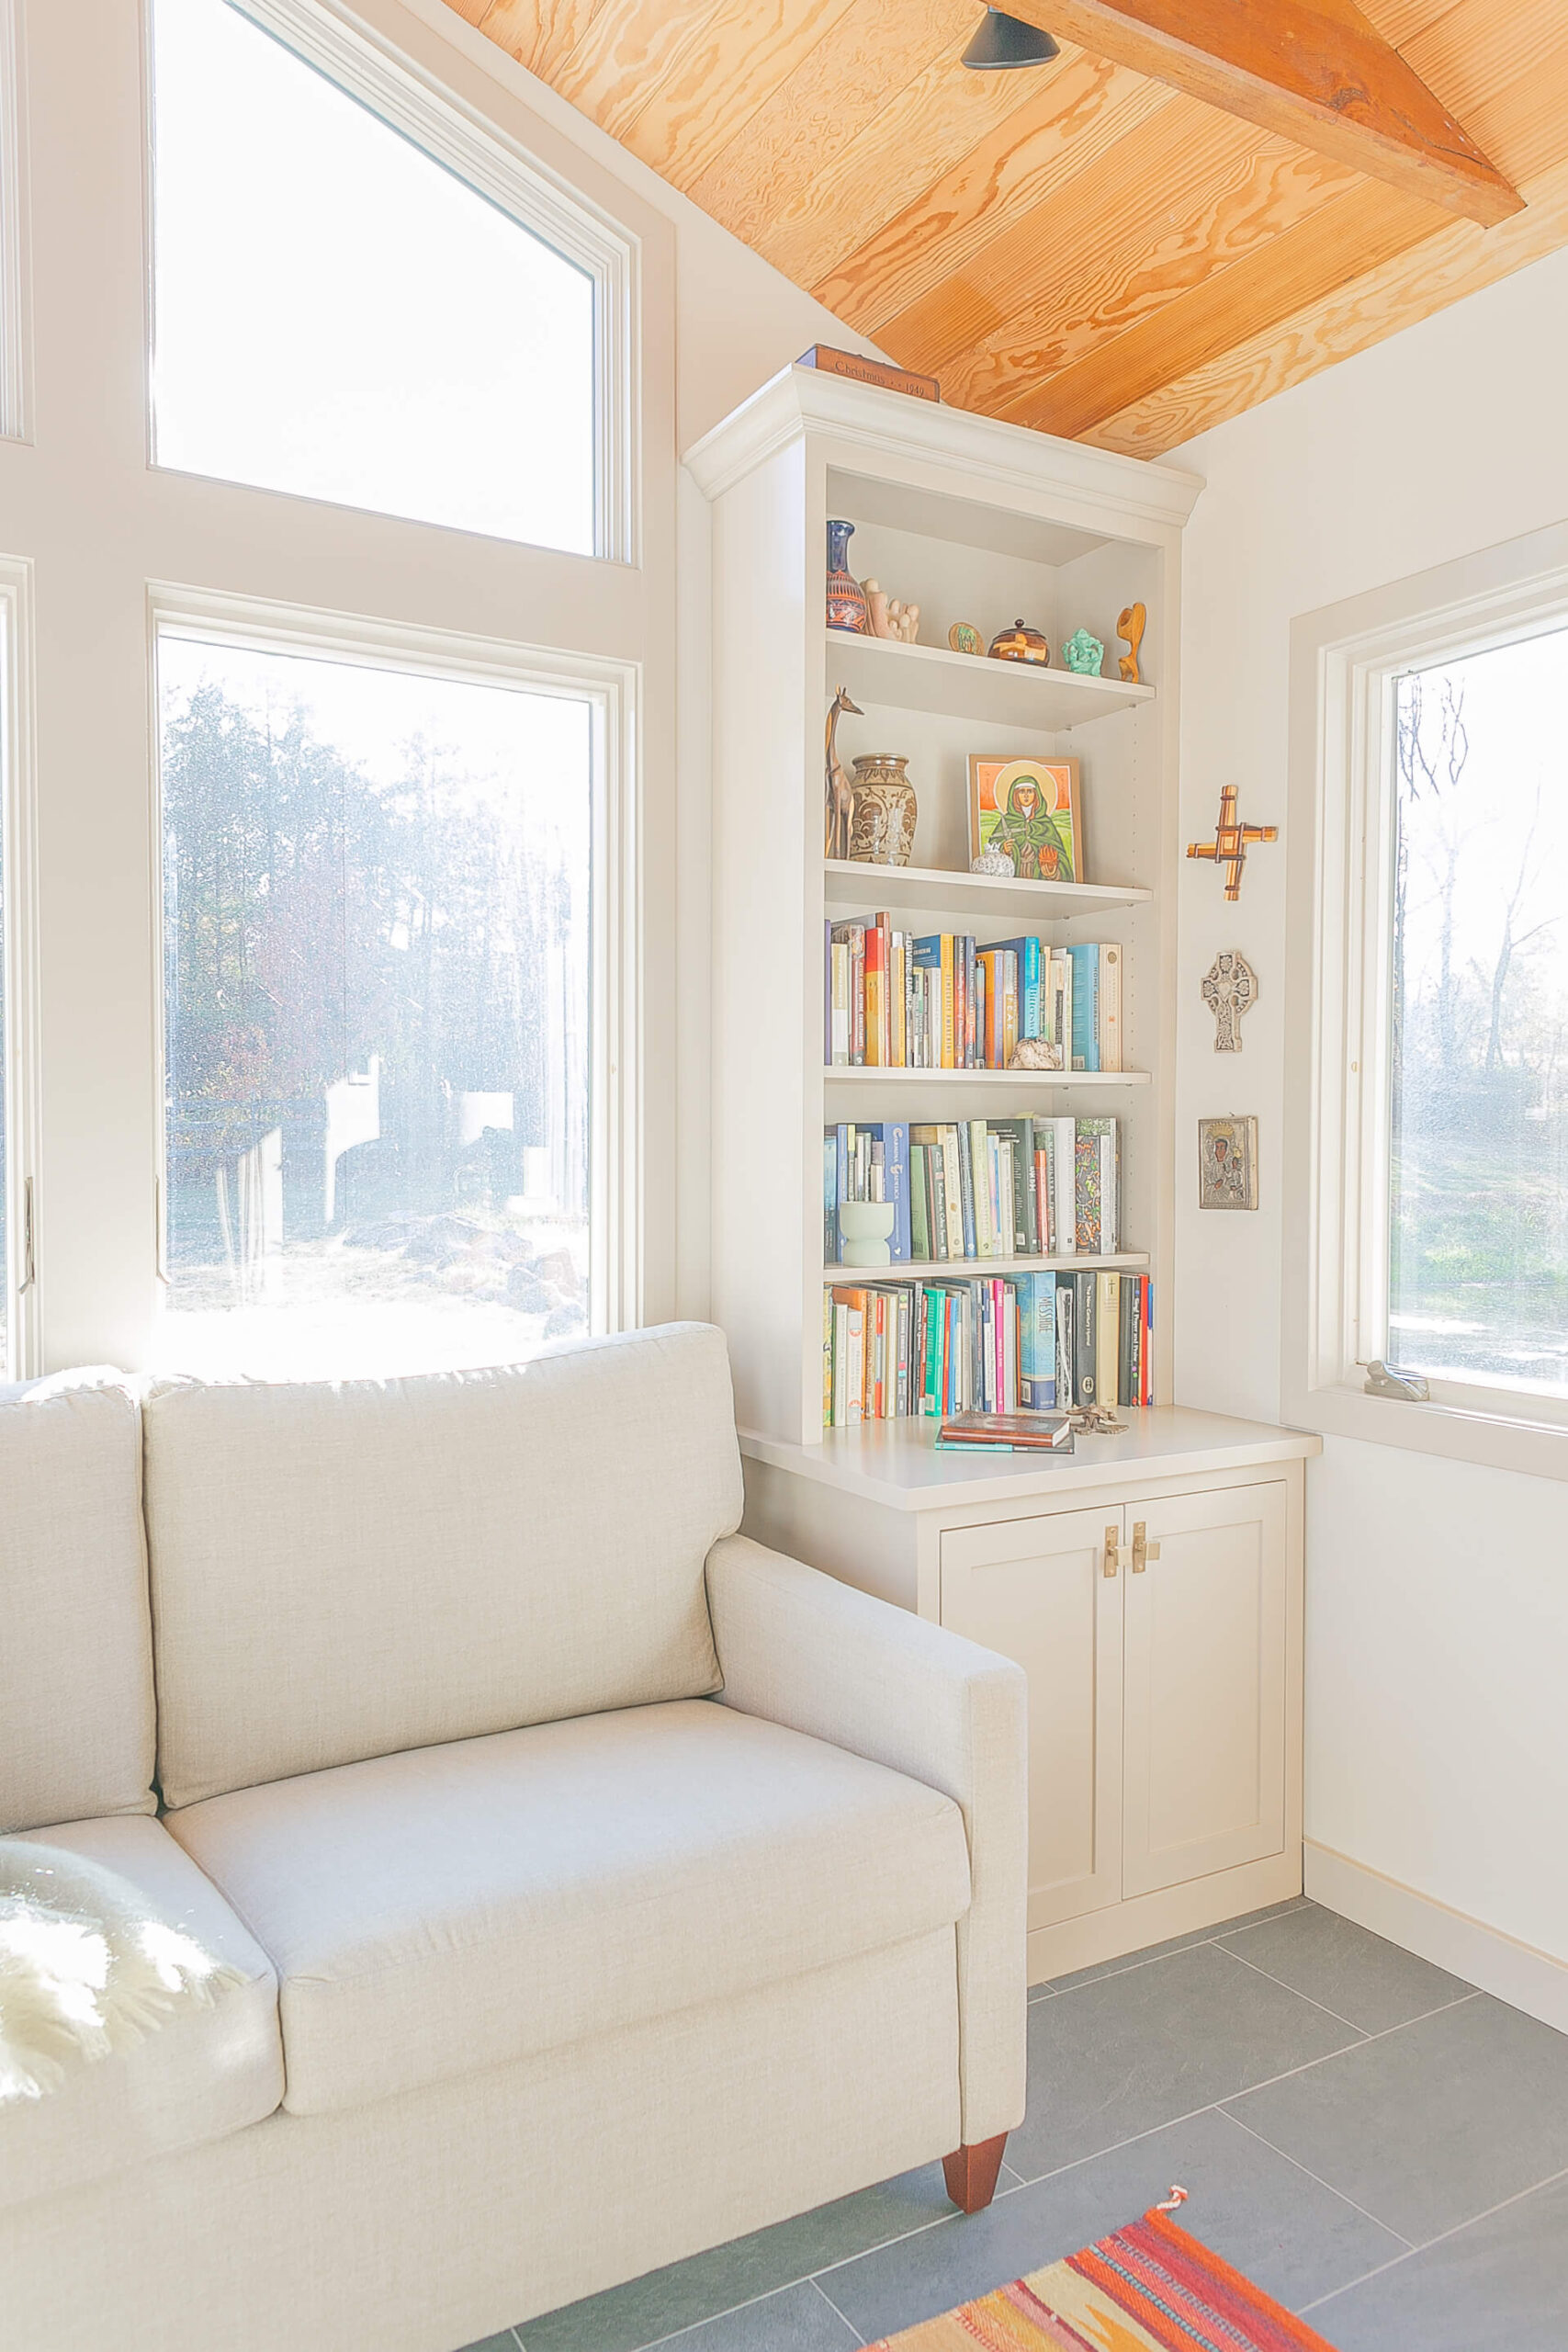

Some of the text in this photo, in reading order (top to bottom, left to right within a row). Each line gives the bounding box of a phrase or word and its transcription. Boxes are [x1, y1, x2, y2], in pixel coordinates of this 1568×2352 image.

[834, 360, 925, 396] Christmas 1949
[1029, 987, 1038, 1035] Bitterswe
[1039, 1296, 1053, 1333] MESSAGE
